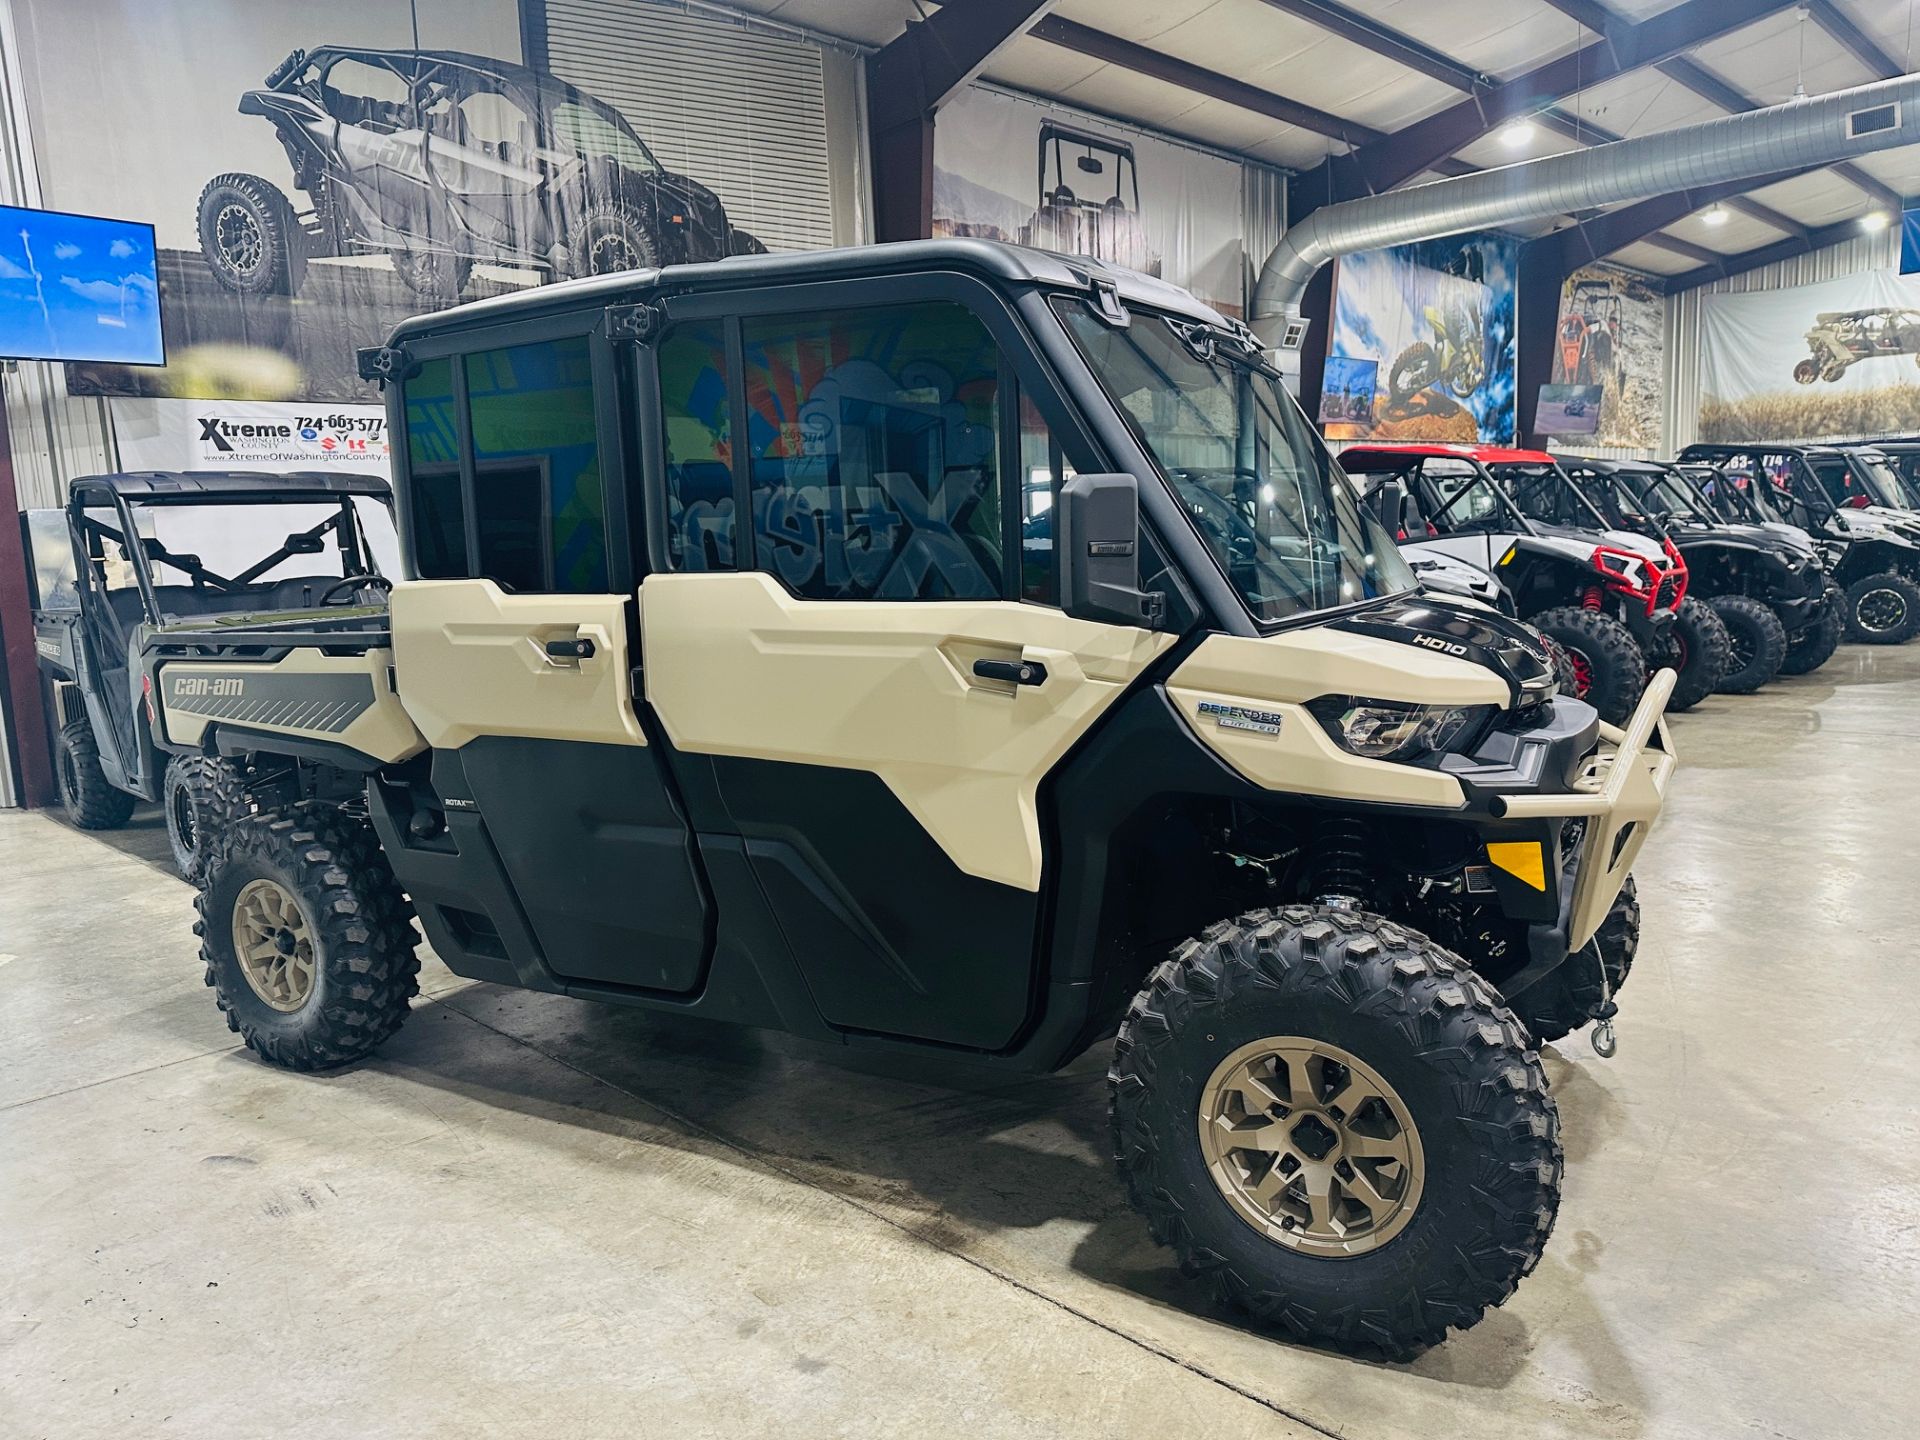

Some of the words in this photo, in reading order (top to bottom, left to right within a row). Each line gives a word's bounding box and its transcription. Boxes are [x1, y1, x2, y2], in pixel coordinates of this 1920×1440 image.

[197, 418, 291, 452] Xtreme
[1412, 633, 1468, 656] HD10
[174, 678, 244, 696] can-am
[1199, 701, 1282, 724] DEFENDER
[445, 798, 466, 806] ROTAX
